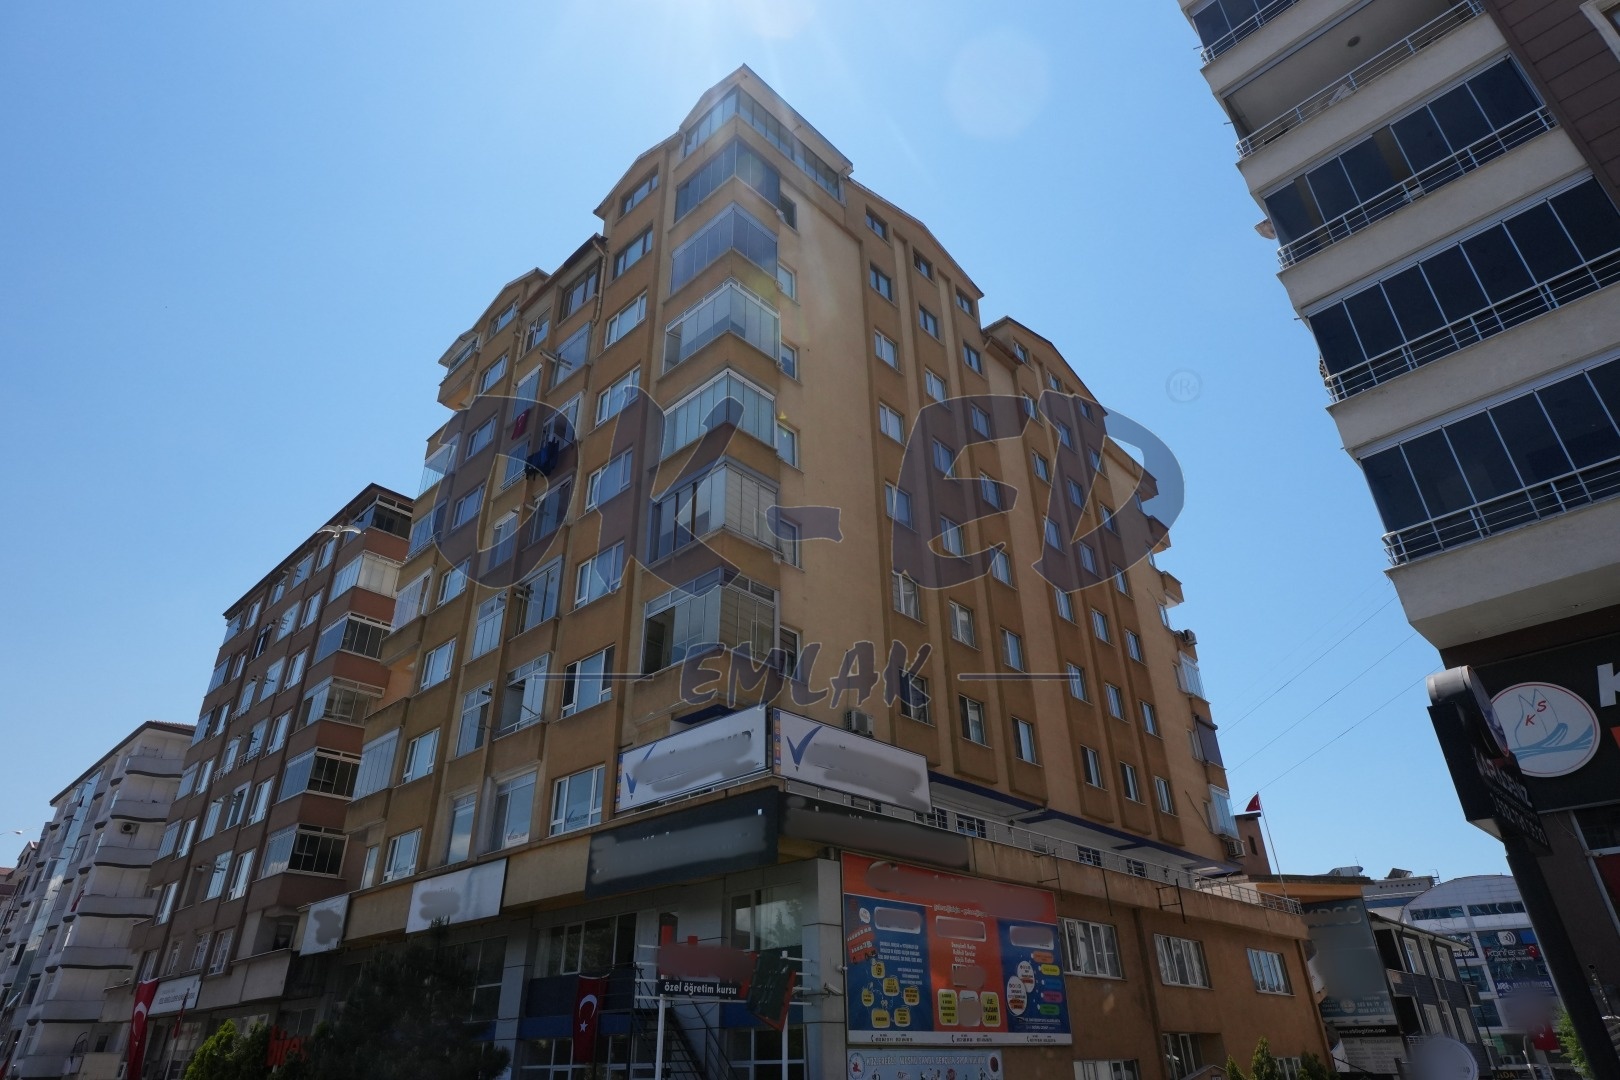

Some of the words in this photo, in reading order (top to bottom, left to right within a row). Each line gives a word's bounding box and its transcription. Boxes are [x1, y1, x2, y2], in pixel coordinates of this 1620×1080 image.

[664, 981, 682, 992] özel
[684, 982, 714, 996] öğretim
[716, 983, 737, 995] kursu
